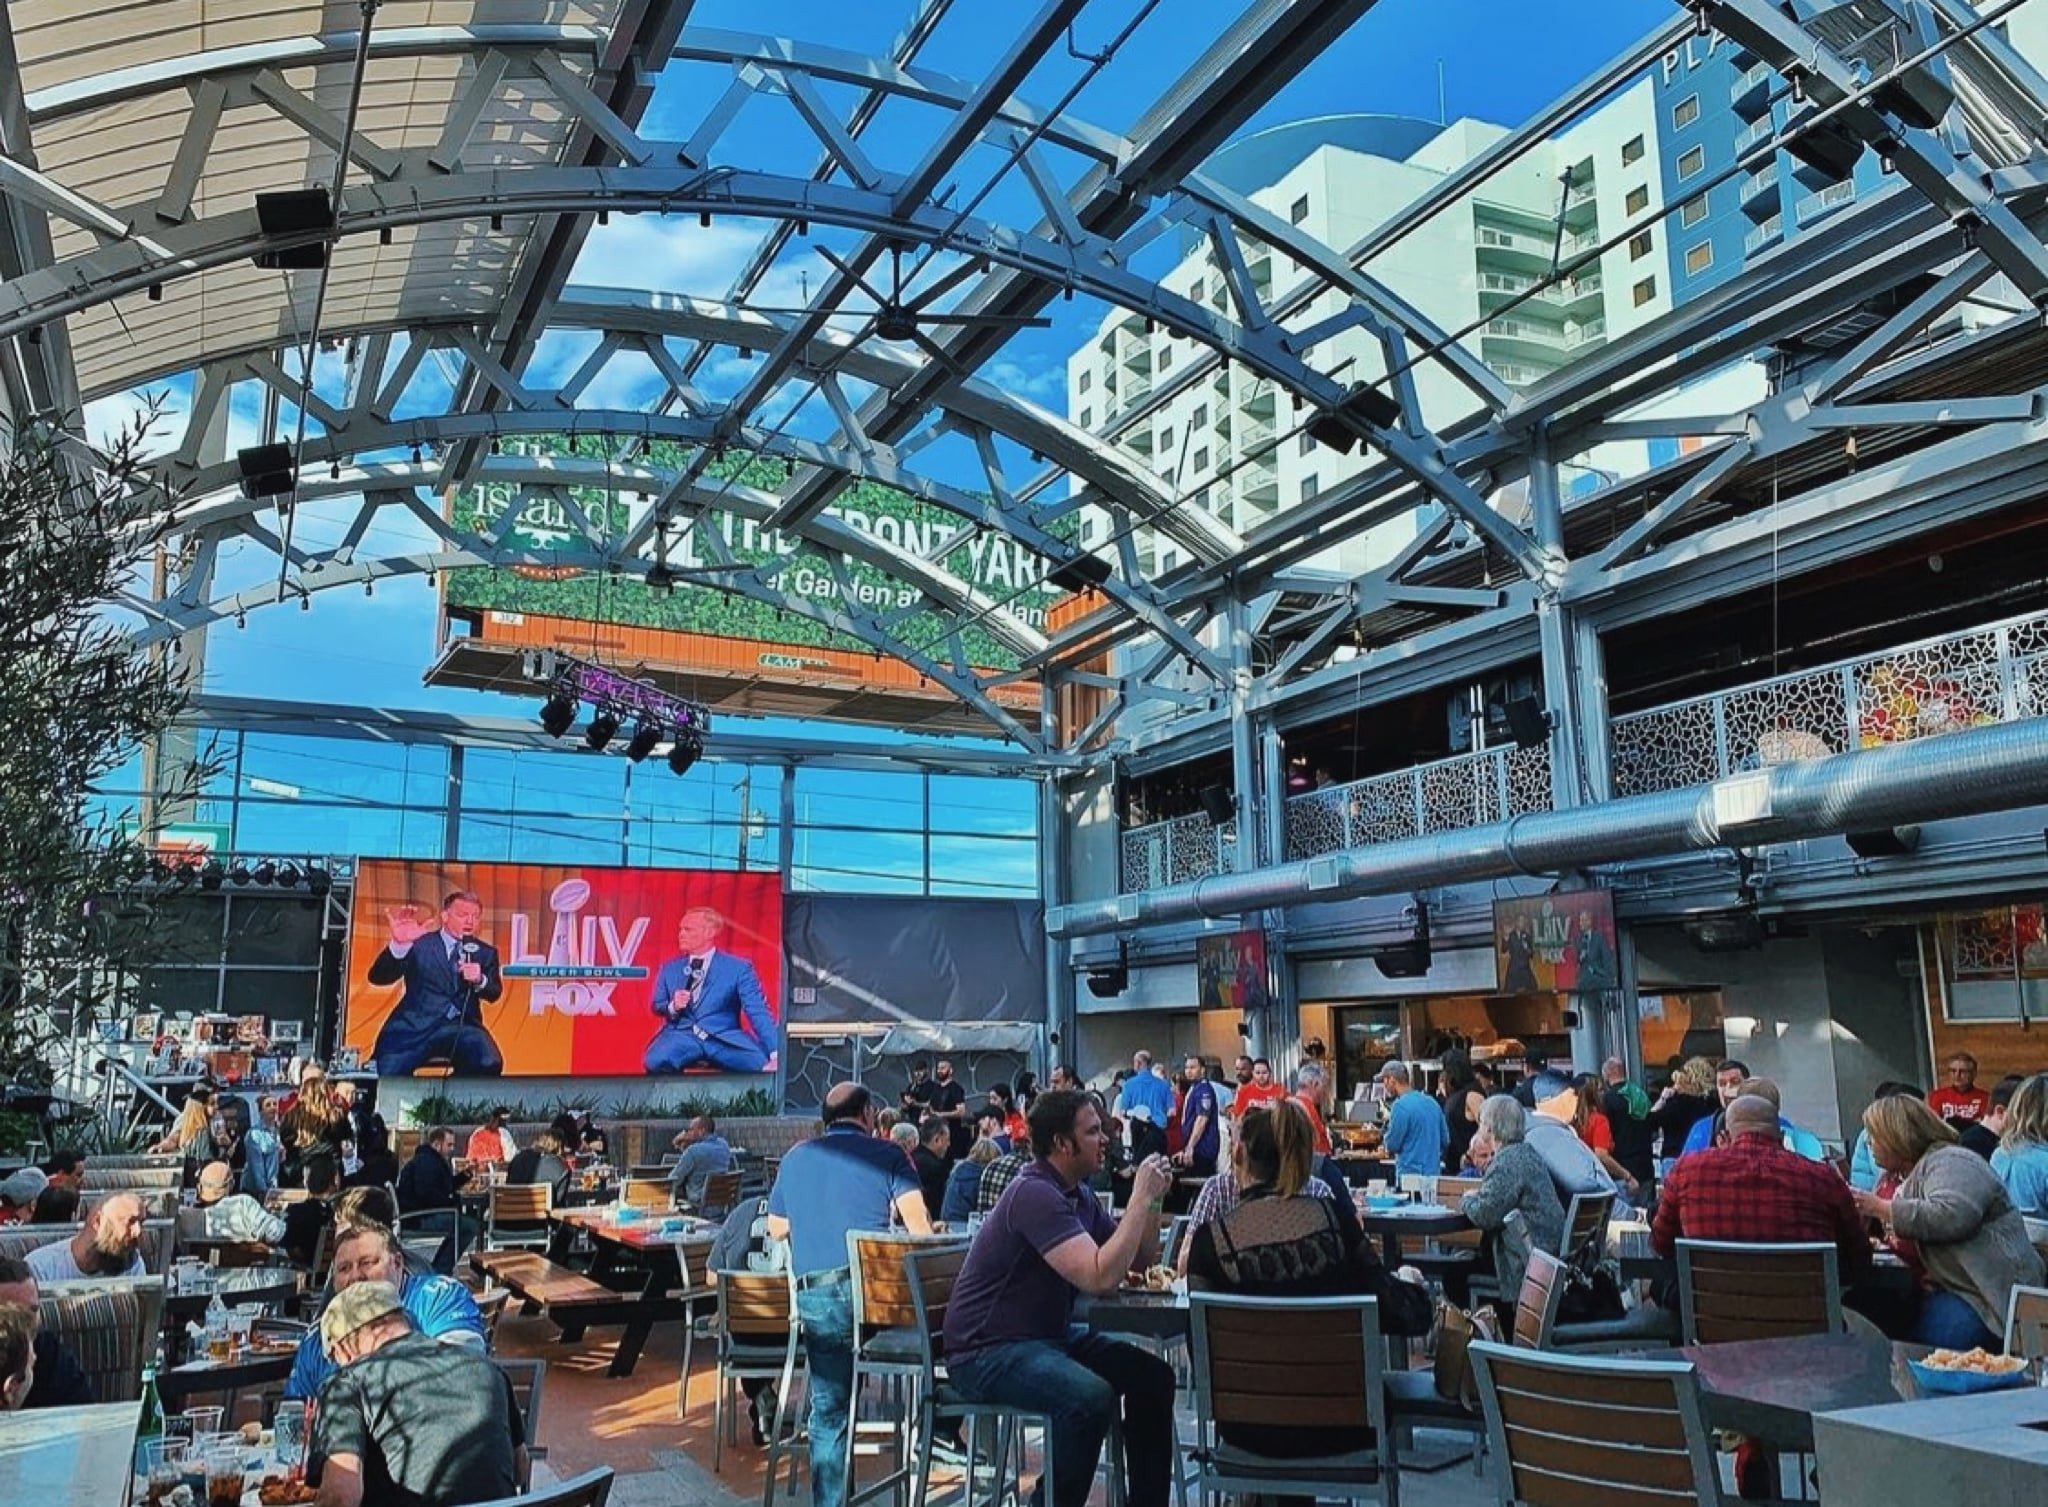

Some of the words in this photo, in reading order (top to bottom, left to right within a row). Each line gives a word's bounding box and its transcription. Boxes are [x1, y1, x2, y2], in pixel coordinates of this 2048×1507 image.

[822, 506, 958, 573] RONT
[529, 966, 578, 977] SUPER
[583, 967, 623, 977] BOWL
[528, 980, 619, 1016] FOX
